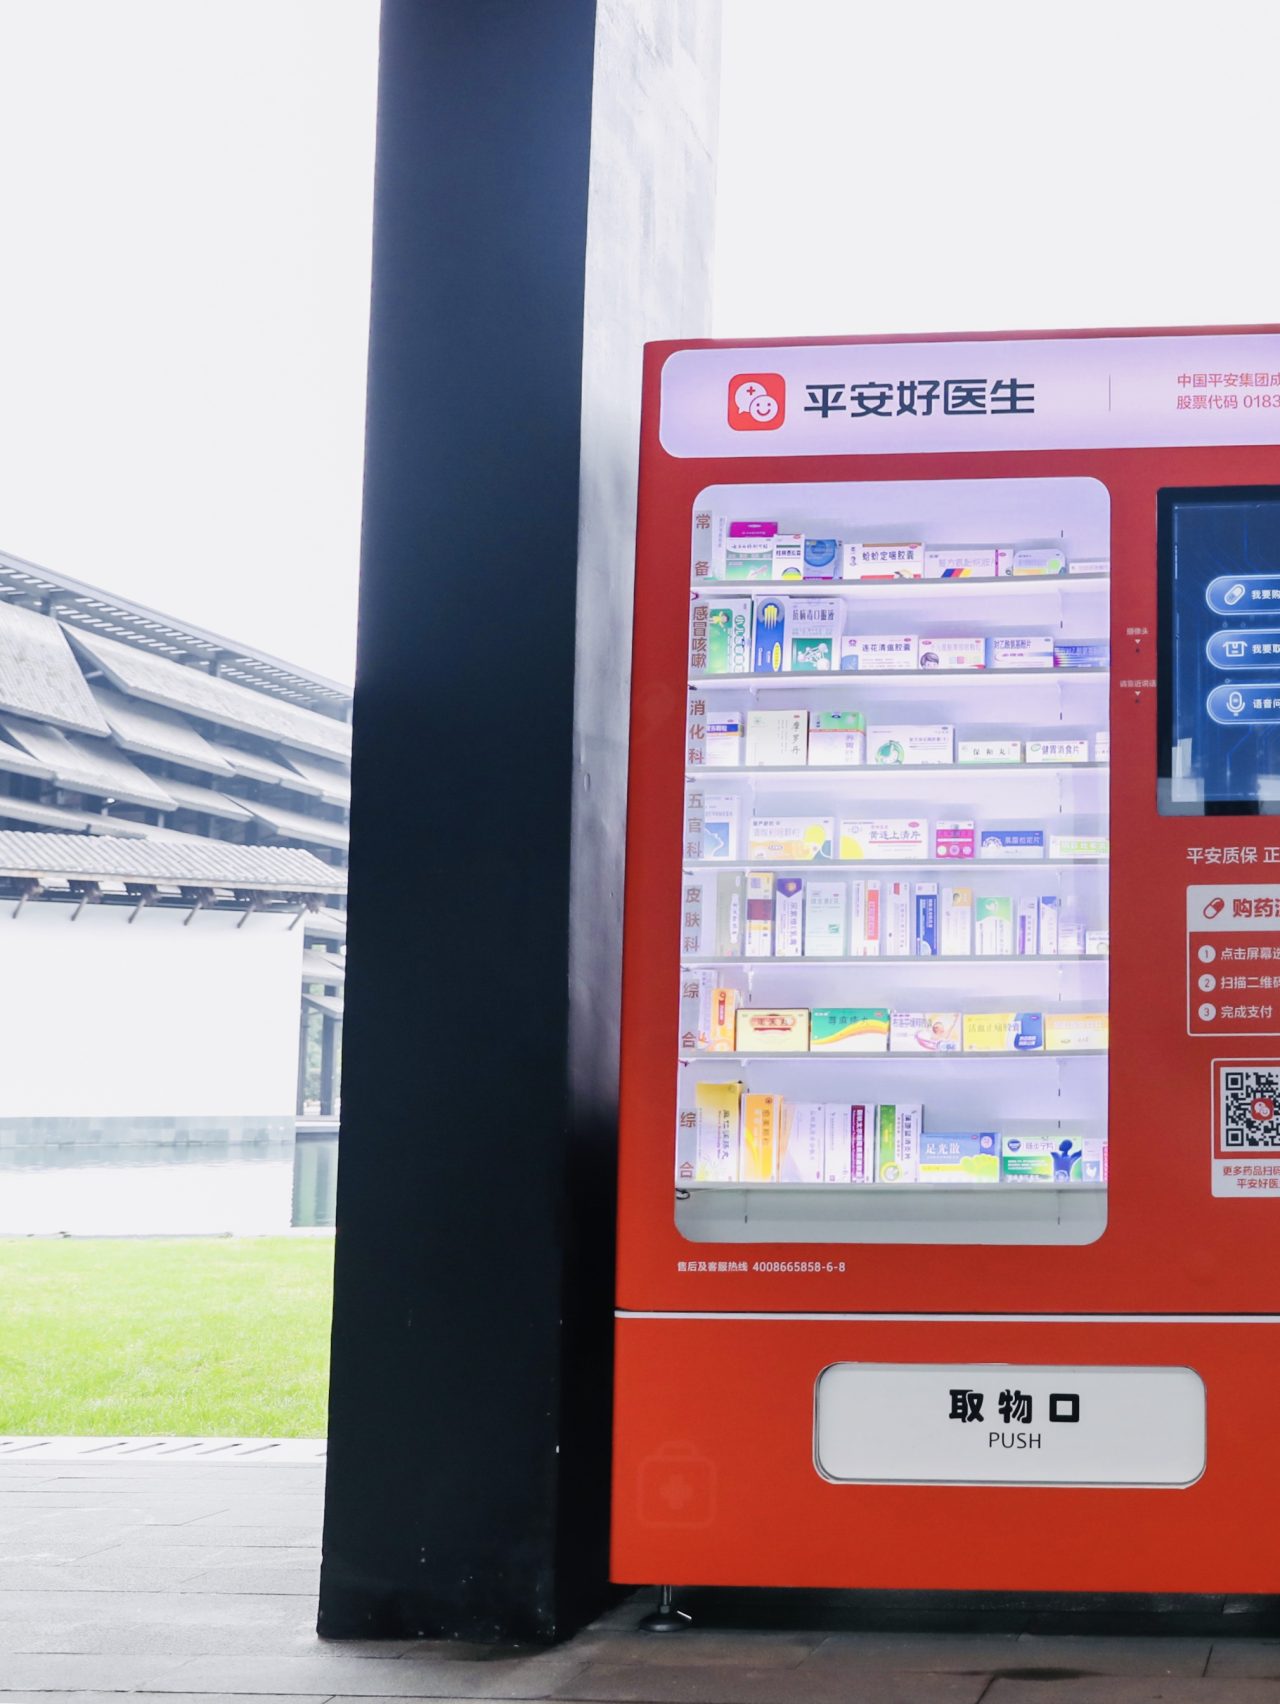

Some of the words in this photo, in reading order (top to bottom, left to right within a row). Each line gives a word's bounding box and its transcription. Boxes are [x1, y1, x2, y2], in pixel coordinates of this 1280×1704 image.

[803, 378, 1036, 418] 平安好医生
[1177, 394, 1238, 411] 股票代码
[695, 513, 711, 577] 常备
[691, 605, 708, 669] 感冒咳嗽
[689, 700, 706, 764] 消化科
[687, 793, 704, 857] 五官科
[1186, 847, 1258, 864] 平安质保
[685, 887, 702, 952] 皮肤科
[682, 983, 699, 1048] 综合
[1221, 1005, 1273, 1019] 完成支付
[680, 1112, 696, 1178] 综合
[677, 1261, 748, 1272] 售后及客服热线
[752, 1262, 846, 1272] 4008665858-6-8
[949, 1389, 1080, 1424] 取物口
[989, 1432, 1042, 1449] PUSH
